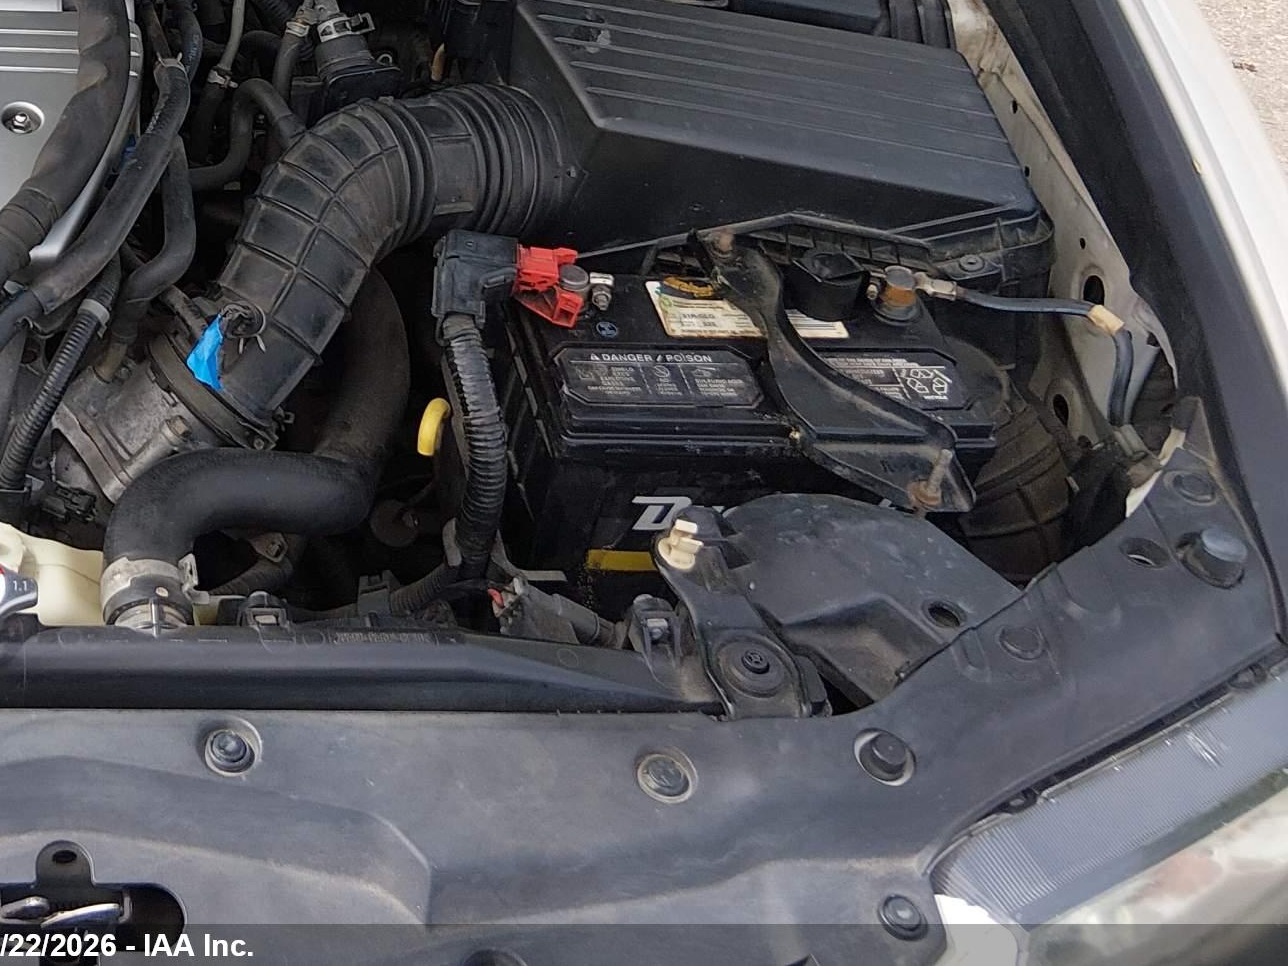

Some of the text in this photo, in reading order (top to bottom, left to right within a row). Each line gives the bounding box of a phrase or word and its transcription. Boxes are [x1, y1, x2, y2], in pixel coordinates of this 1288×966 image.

[601, 353, 653, 363] DANGER
[666, 353, 713, 363] POISON
[13, 580, 28, 592] 1.1
